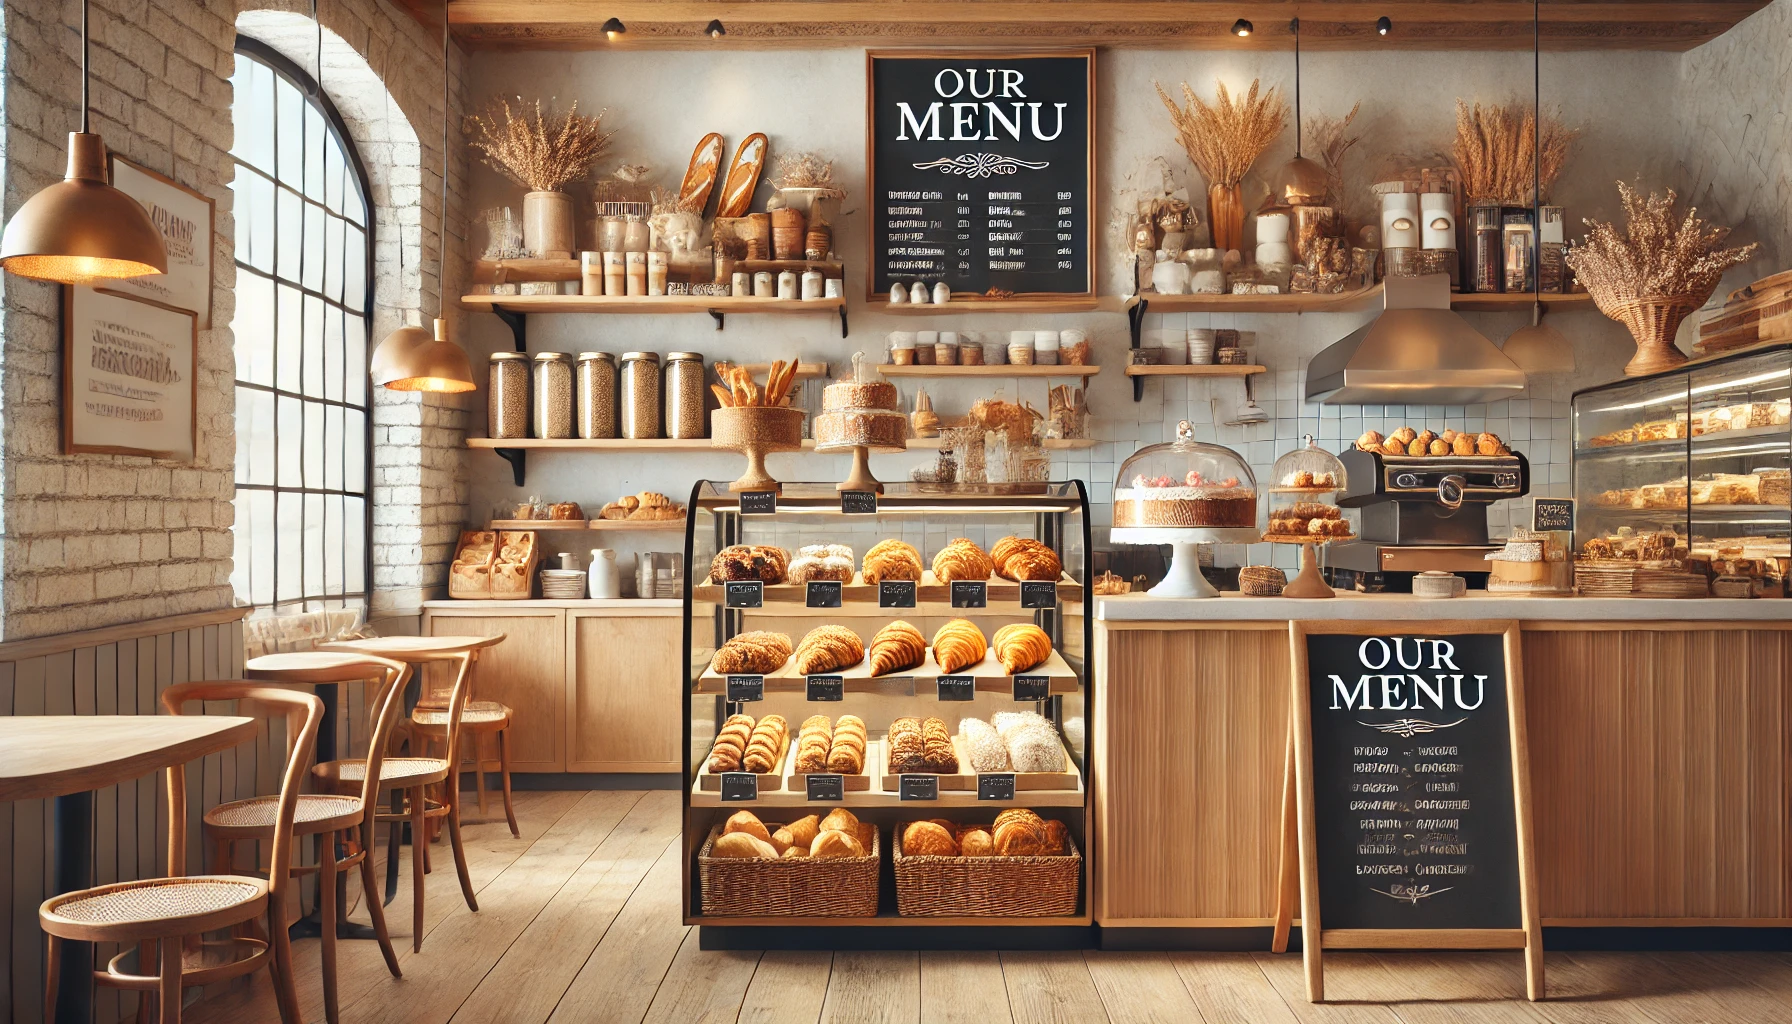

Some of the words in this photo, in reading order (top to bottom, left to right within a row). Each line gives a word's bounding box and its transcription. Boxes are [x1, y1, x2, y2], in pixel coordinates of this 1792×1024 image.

[934, 68, 1027, 99] OUR
[895, 102, 1068, 142] MENU
[1358, 636, 1461, 671] OUR
[1327, 673, 1488, 711] MENU
